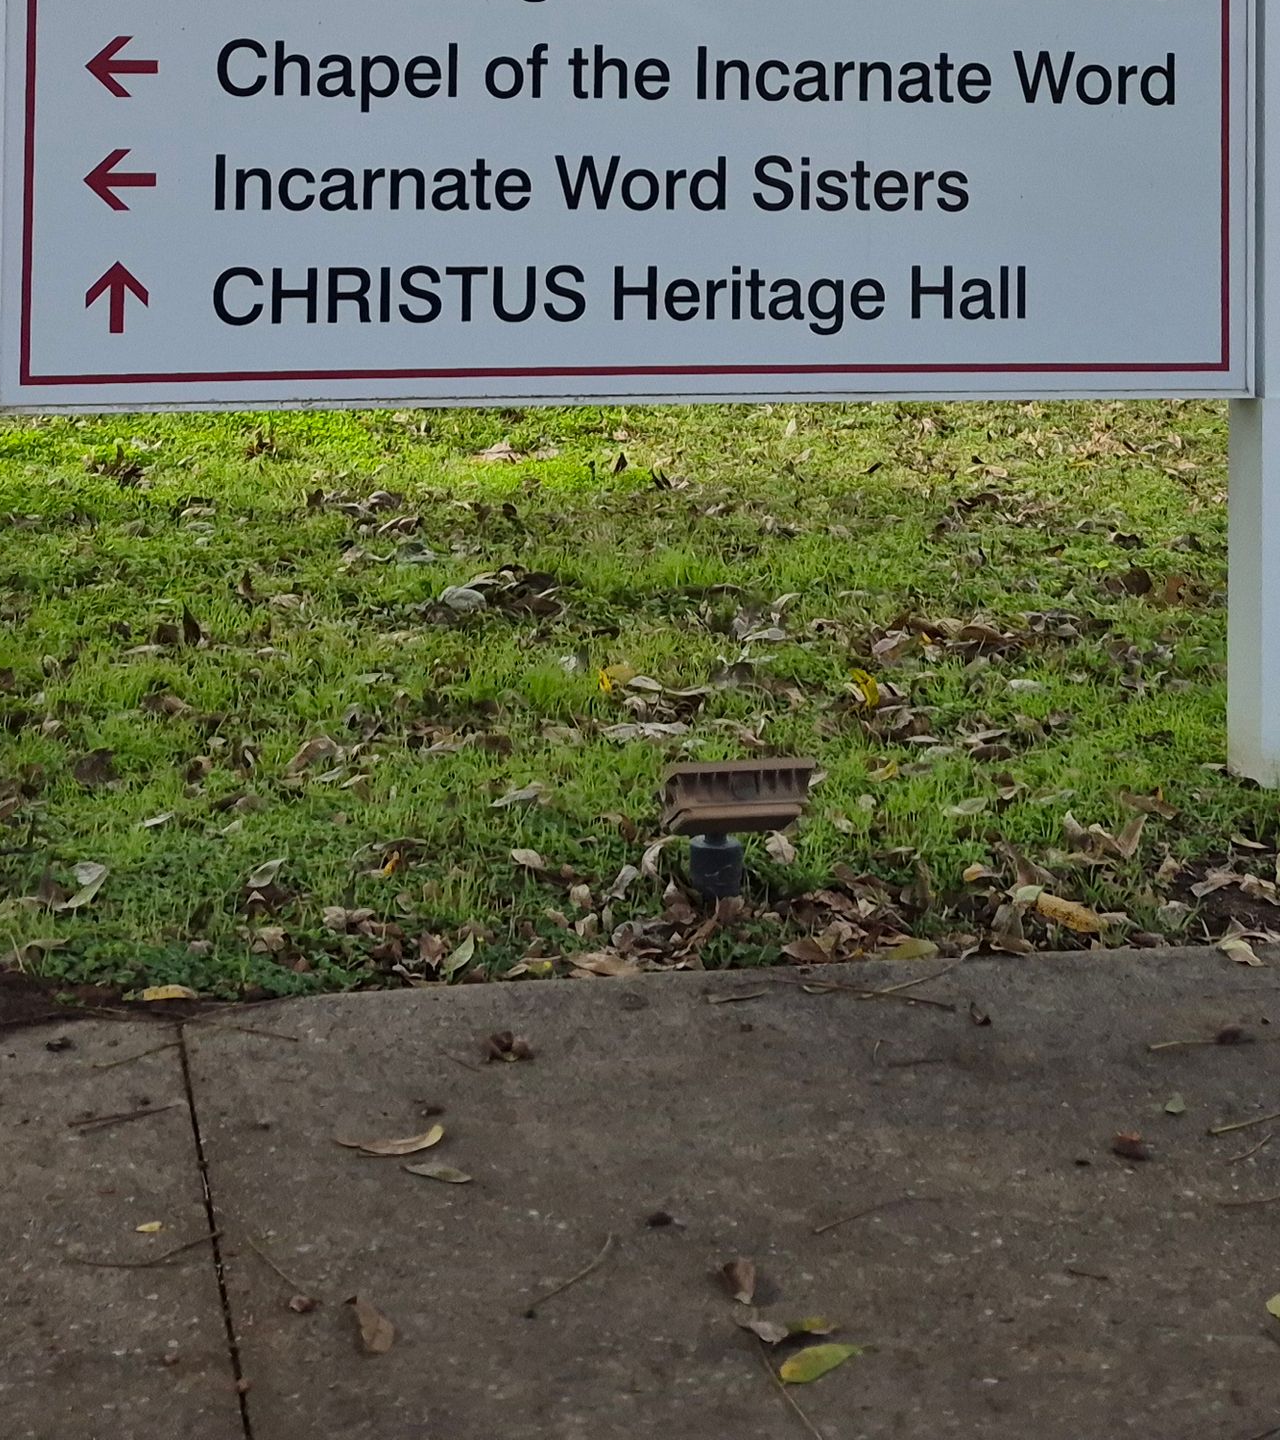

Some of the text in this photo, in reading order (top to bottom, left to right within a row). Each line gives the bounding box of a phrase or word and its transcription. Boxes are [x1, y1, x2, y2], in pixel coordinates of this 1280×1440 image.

[215, 38, 1177, 113] Chapel of the Incarnate Word
[214, 154, 970, 213] Incarnate Word Sisters
[213, 265, 1027, 336] CHRISTUS Heritage Hall
